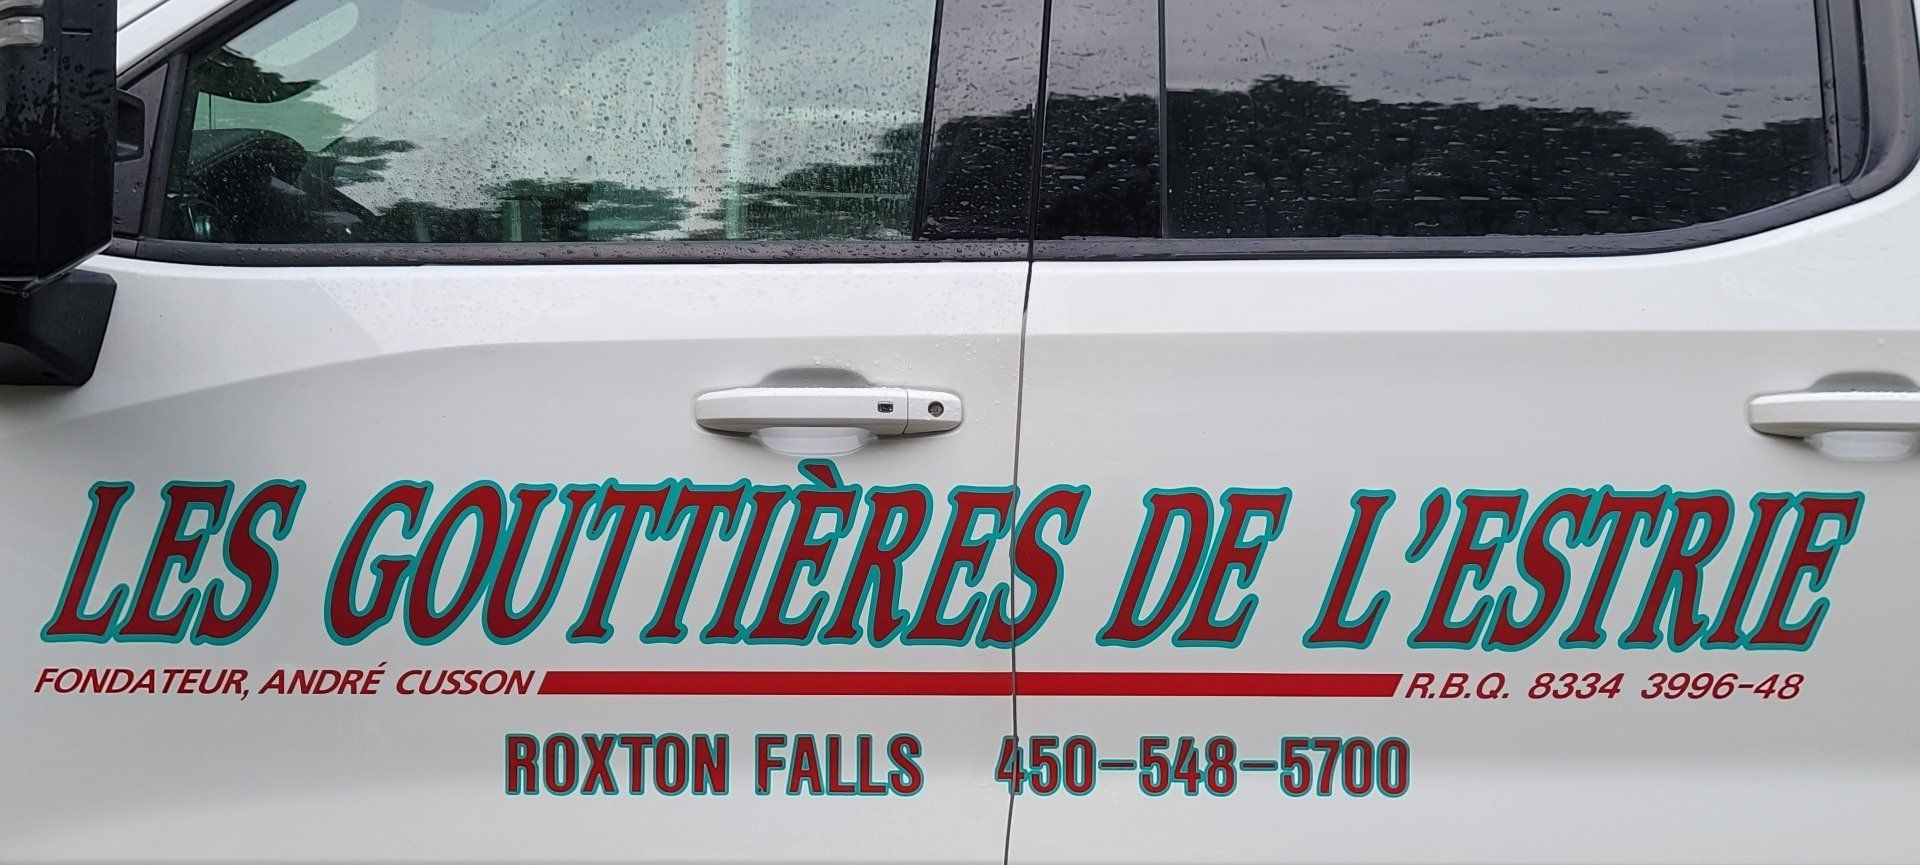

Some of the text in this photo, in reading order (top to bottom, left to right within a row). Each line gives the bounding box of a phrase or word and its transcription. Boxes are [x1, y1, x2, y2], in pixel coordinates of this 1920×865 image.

[40, 458, 1866, 653] LES GOUTTIÈRES DE L'ESTRIE
[34, 661, 535, 701] FONDATEUR, ANDRÉ CUSSON
[1404, 672, 1805, 700] R.B.Q. 8334 3996-48
[505, 732, 1411, 799] ROXTON FALLS 450-548-5700
